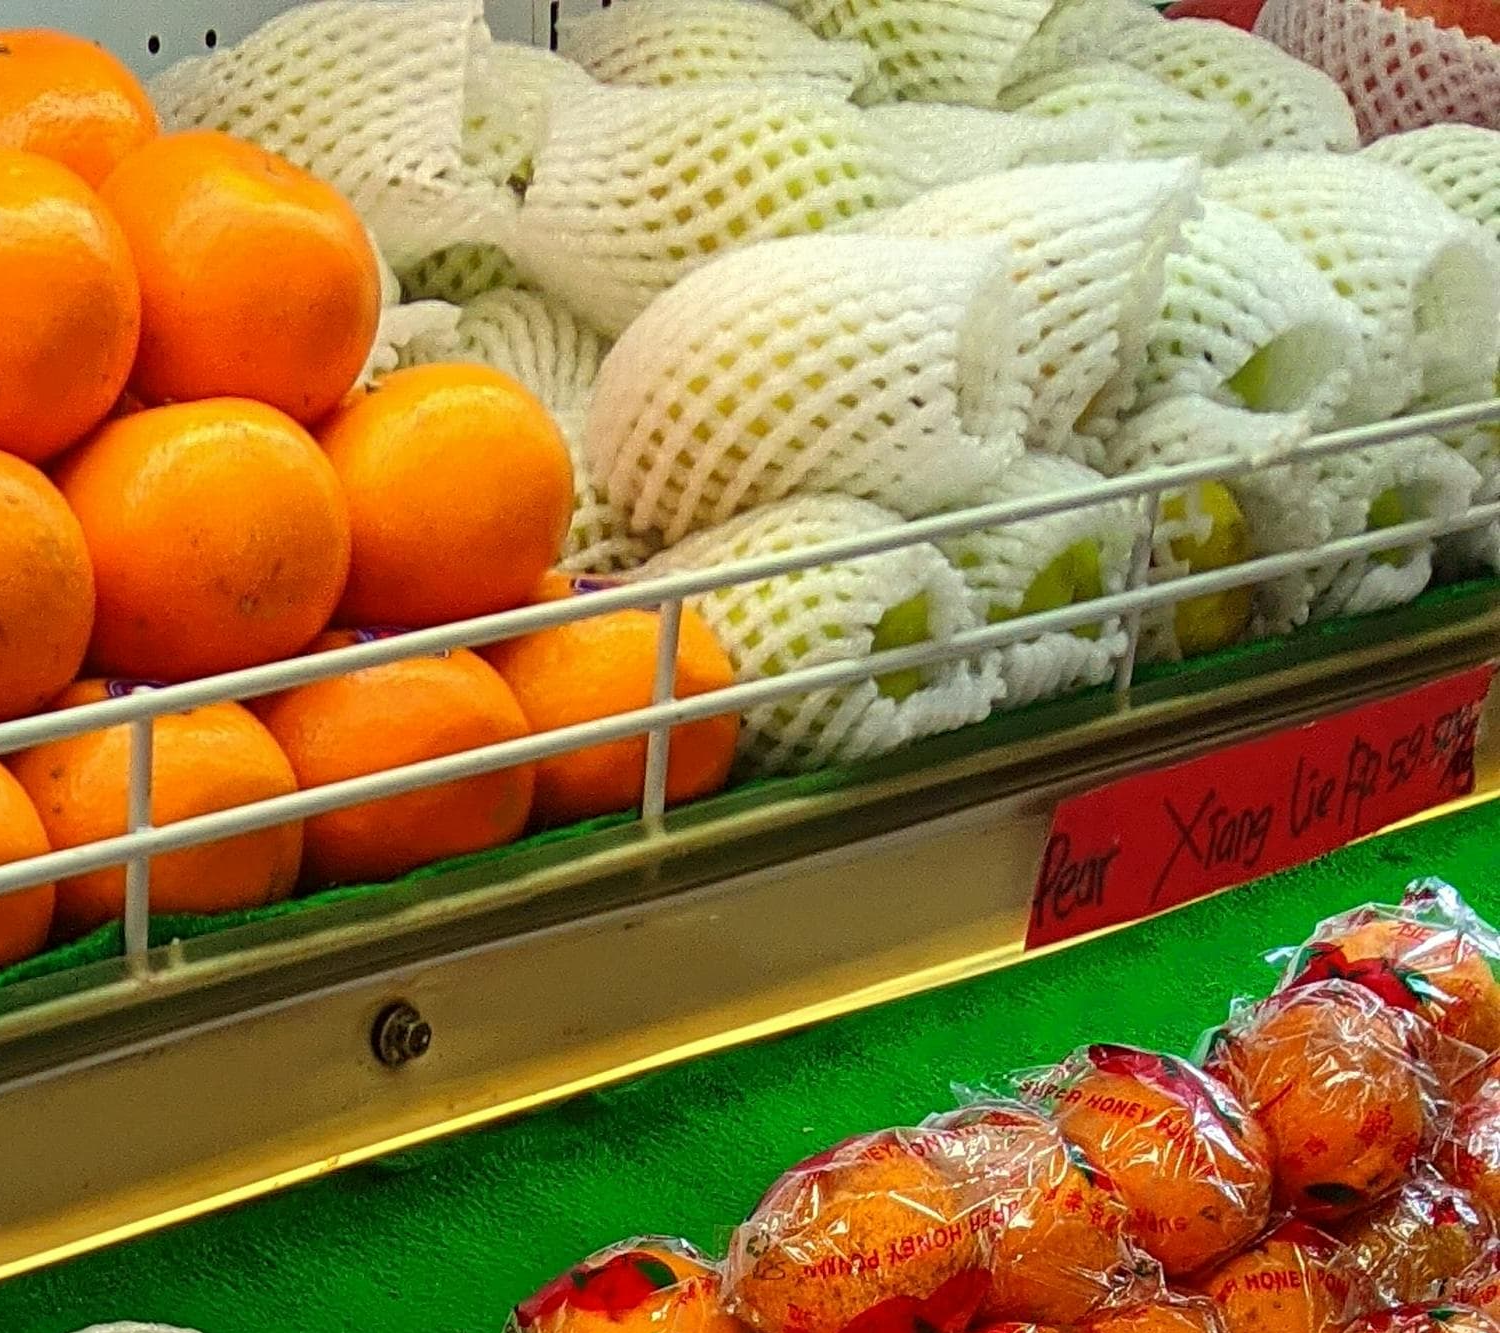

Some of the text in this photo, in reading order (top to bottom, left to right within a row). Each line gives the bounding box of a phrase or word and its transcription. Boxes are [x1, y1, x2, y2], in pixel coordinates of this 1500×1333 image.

[1033, 832, 1123, 929] Pear
[1018, 1079, 1083, 1103] SUPER
[1084, 1092, 1151, 1124] HONEY
[968, 1198, 1022, 1235] UPER
[888, 1226, 963, 1266] HONEY
